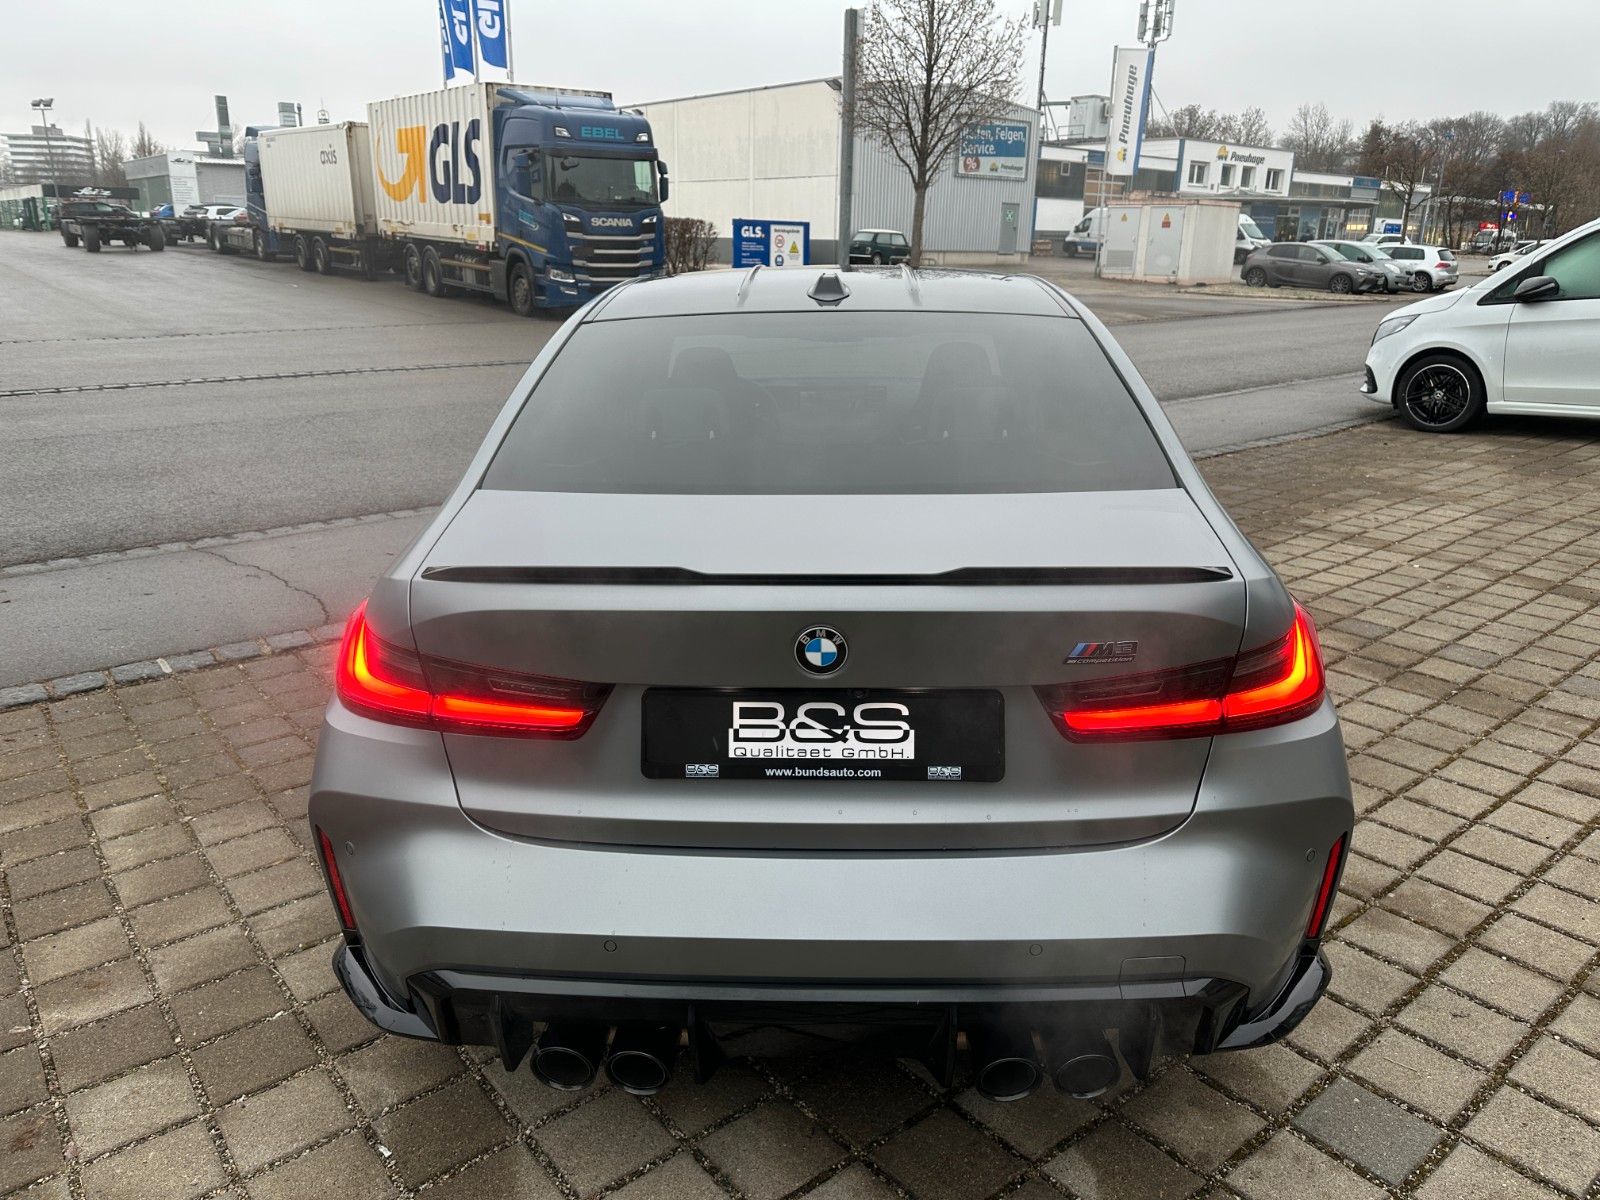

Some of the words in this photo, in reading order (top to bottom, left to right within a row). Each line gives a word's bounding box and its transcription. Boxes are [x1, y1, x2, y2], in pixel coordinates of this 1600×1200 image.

[1118, 64, 1138, 144] Pneuhage
[581, 126, 625, 140] EBEL
[995, 127, 1025, 144] Felgen,
[320, 144, 337, 164] axis
[962, 141, 996, 155] Service.
[430, 119, 481, 204] GLS
[1230, 151, 1265, 165] Pneuhage
[591, 217, 633, 227] SCANIA
[800, 629, 843, 645] BMW
[733, 701, 910, 743] B&S
[733, 745, 831, 758] Qualitaet
[841, 748, 910, 759] GmbH.
[687, 764, 718, 775] B&S
[765, 767, 881, 777] www.bundsauto.com
[928, 767, 960, 776] B&S
